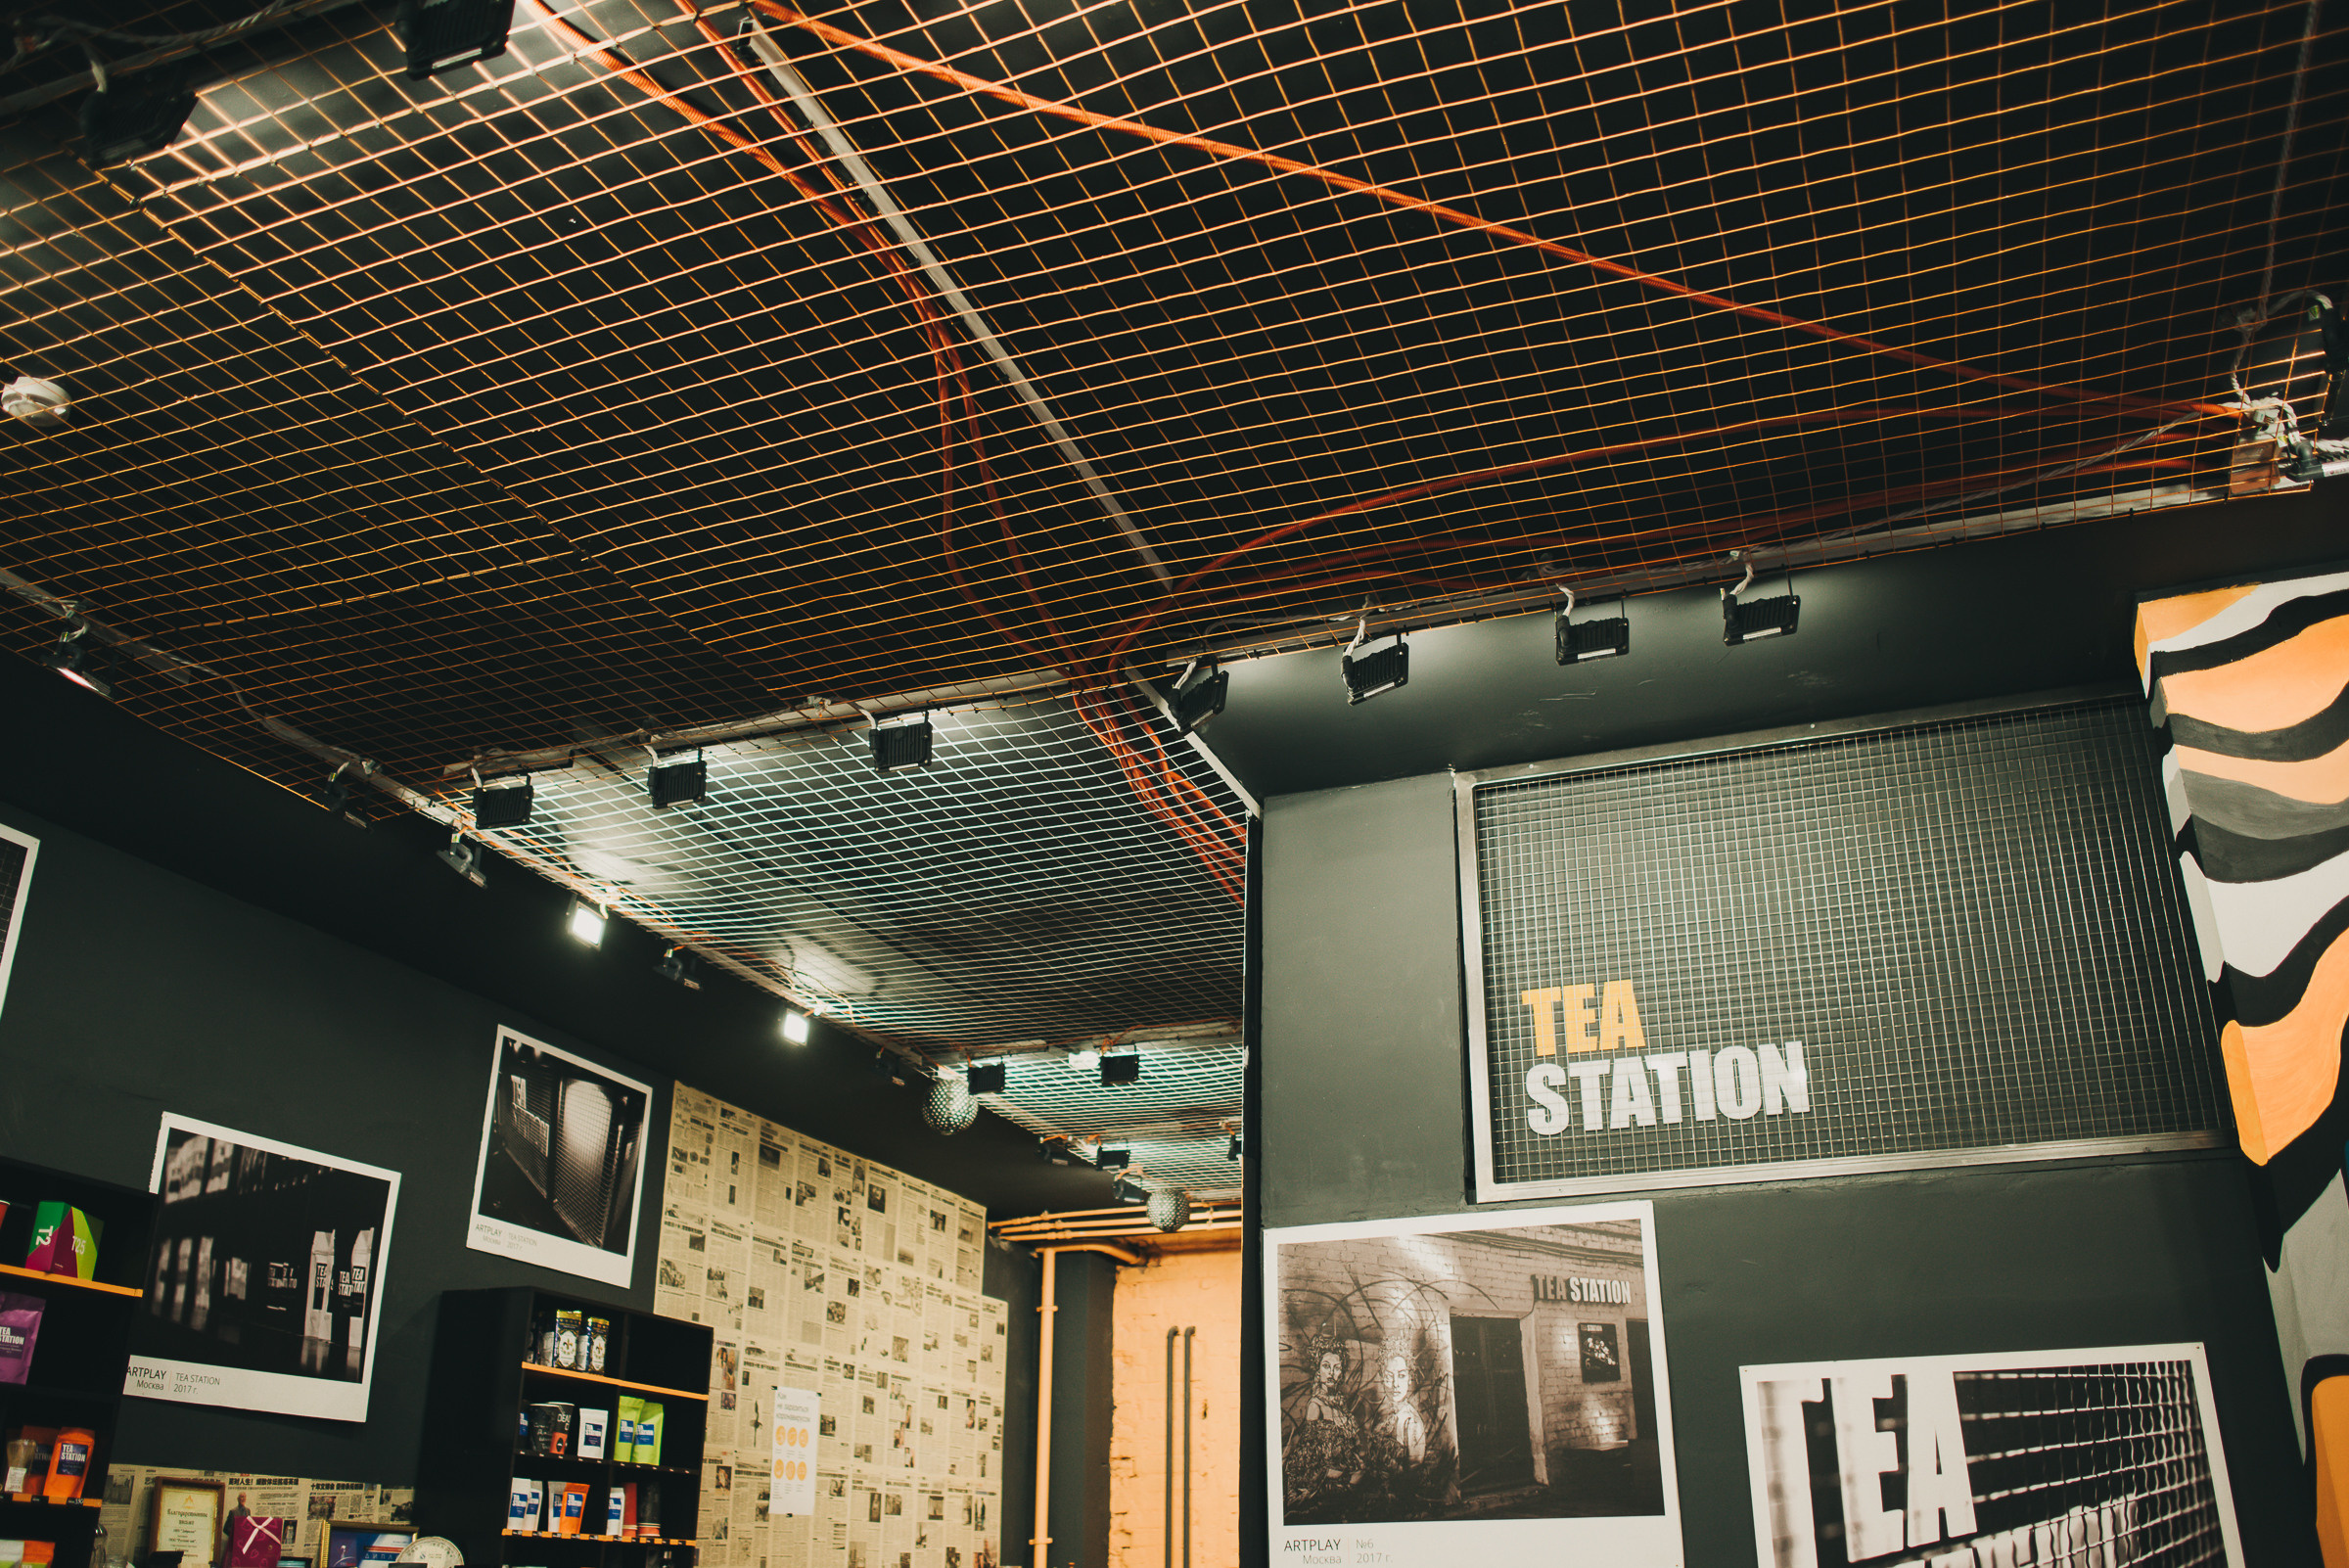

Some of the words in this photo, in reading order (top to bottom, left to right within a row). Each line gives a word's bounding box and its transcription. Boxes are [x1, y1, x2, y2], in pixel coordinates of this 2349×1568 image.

[1522, 979, 1646, 1057] TEA
[1525, 1040, 1811, 1136] STATION
[35, 1225, 53, 1246] T2
[475, 1223, 503, 1237] ARTPLAY
[71, 1235, 86, 1255] T25
[339, 1270, 350, 1284] TEA
[353, 1268, 364, 1280] TEA
[1534, 1274, 1567, 1301] TEA
[1569, 1276, 1632, 1304] STATION
[126, 1366, 167, 1380] ARTPLAY
[175, 1372, 189, 1382] TEA
[190, 1374, 220, 1386] STATION
[137, 1379, 164, 1391] Москва
[173, 1384, 192, 1394] 2017
[63, 1444, 73, 1453] TEA
[61, 1452, 86, 1462] STATION
[1284, 1539, 1341, 1551] ARTPLAY
[1356, 1538, 1374, 1549] №6
[1303, 1554, 1342, 1565] Москва
[1357, 1552, 1382, 1564] 2017
